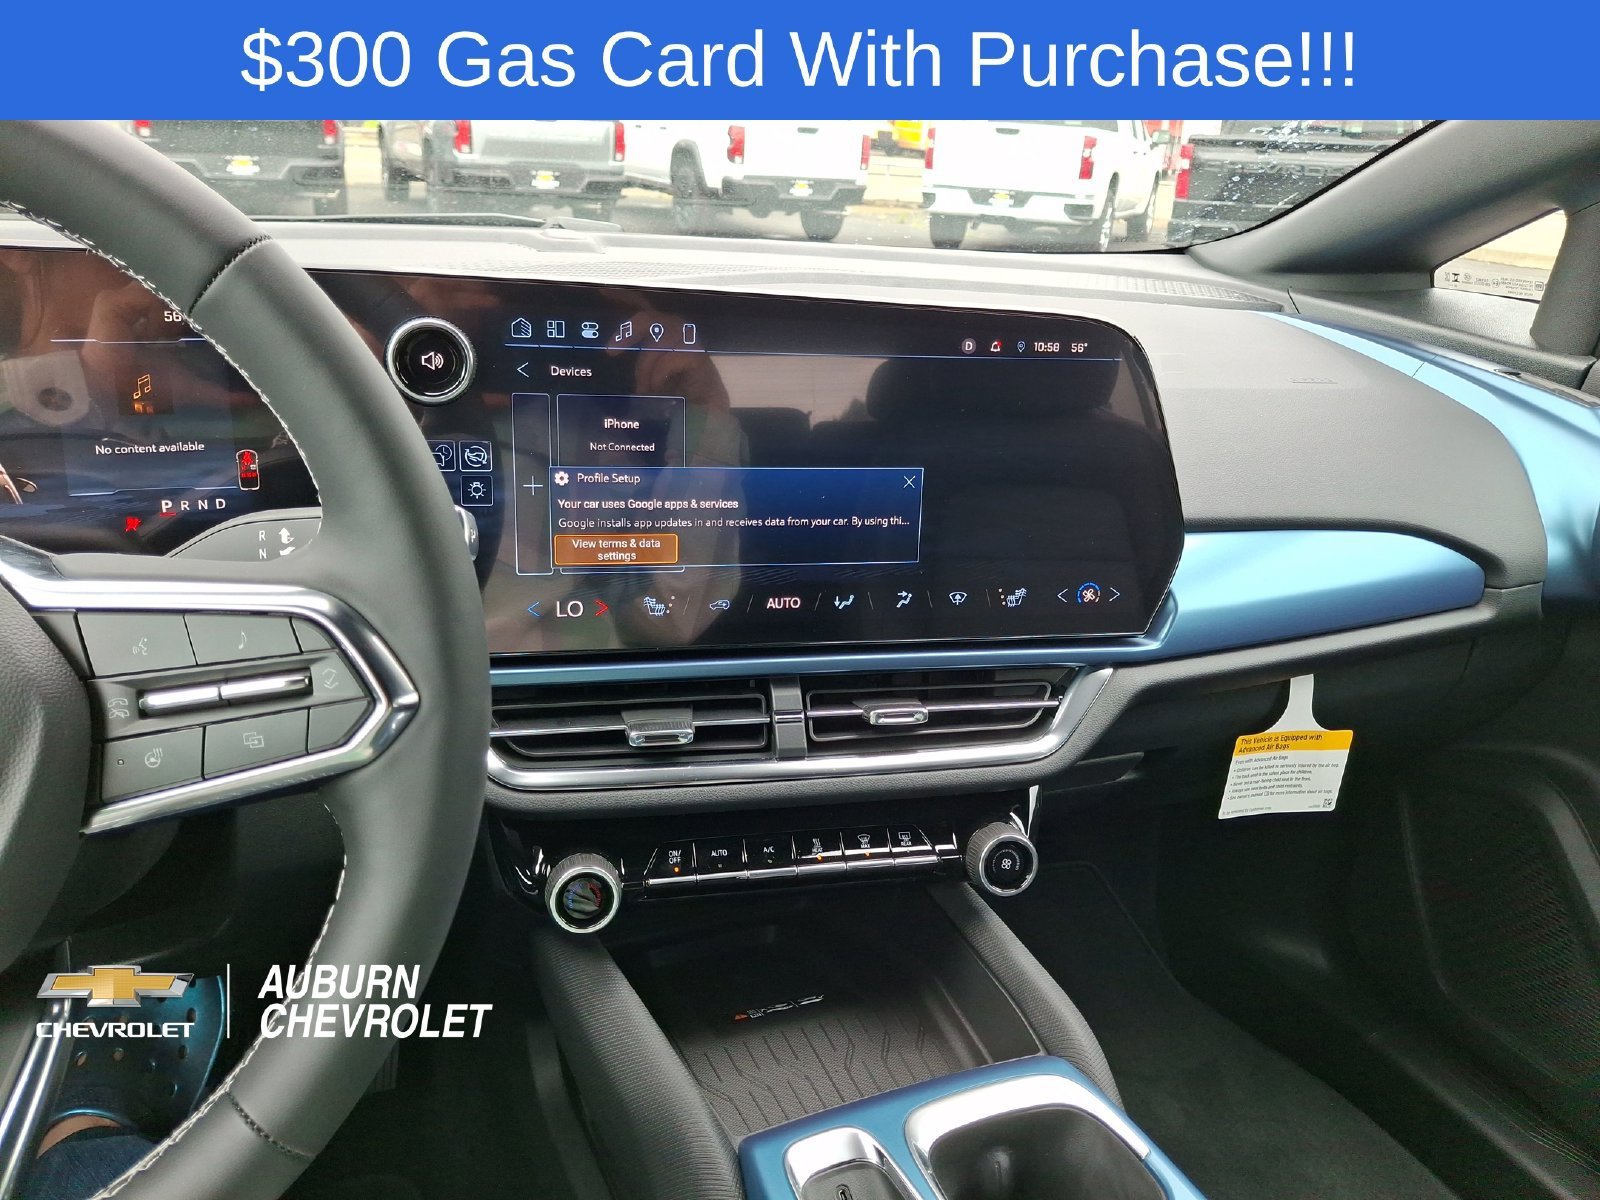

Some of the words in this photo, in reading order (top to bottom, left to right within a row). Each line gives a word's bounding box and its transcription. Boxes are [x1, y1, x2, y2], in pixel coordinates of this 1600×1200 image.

[965, 341, 974, 351] D
[1033, 341, 1061, 352] 10:58
[550, 365, 593, 377] Devices
[604, 418, 640, 429] iPhone
[95, 445, 112, 455] No
[114, 443, 157, 454] content
[158, 441, 205, 453] available
[589, 442, 607, 452] Not
[608, 442, 656, 452] Connected
[577, 472, 610, 483] Profile
[611, 473, 641, 486] Setup
[161, 499, 173, 513] P
[180, 500, 190, 511] R
[198, 499, 209, 510] N
[215, 498, 226, 509] D
[557, 499, 582, 509] Your
[583, 500, 600, 509] car
[601, 500, 626, 509] uses
[627, 499, 663, 511] Google
[664, 500, 689, 511] apps
[690, 499, 698, 509] &
[699, 499, 739, 509] services
[558, 517, 595, 529] Google
[597, 517, 632, 528] installs
[633, 519, 652, 529] app
[654, 517, 693, 529] updates
[694, 517, 703, 527] in
[705, 517, 723, 527] and
[725, 517, 763, 527] receives
[764, 516, 785, 527] data
[787, 516, 809, 526] from
[810, 518, 831, 528] your
[832, 518, 849, 526] car.
[851, 516, 863, 528] By
[864, 516, 888, 528] using
[571, 538, 597, 549] View
[598, 539, 628, 548] terms
[629, 538, 637, 548] &
[638, 538, 661, 548] data
[597, 550, 637, 562] settings
[556, 600, 584, 618] LO
[766, 597, 801, 610] AUTO
[1253, 736, 1272, 744] Vehicle
[1280, 734, 1308, 742] Equipped
[1238, 745, 1265, 753] Advanced
[1275, 743, 1290, 751] Bags
[710, 849, 728, 857] AUTO
[763, 845, 775, 853] A/C
[668, 857, 682, 865] OFF
